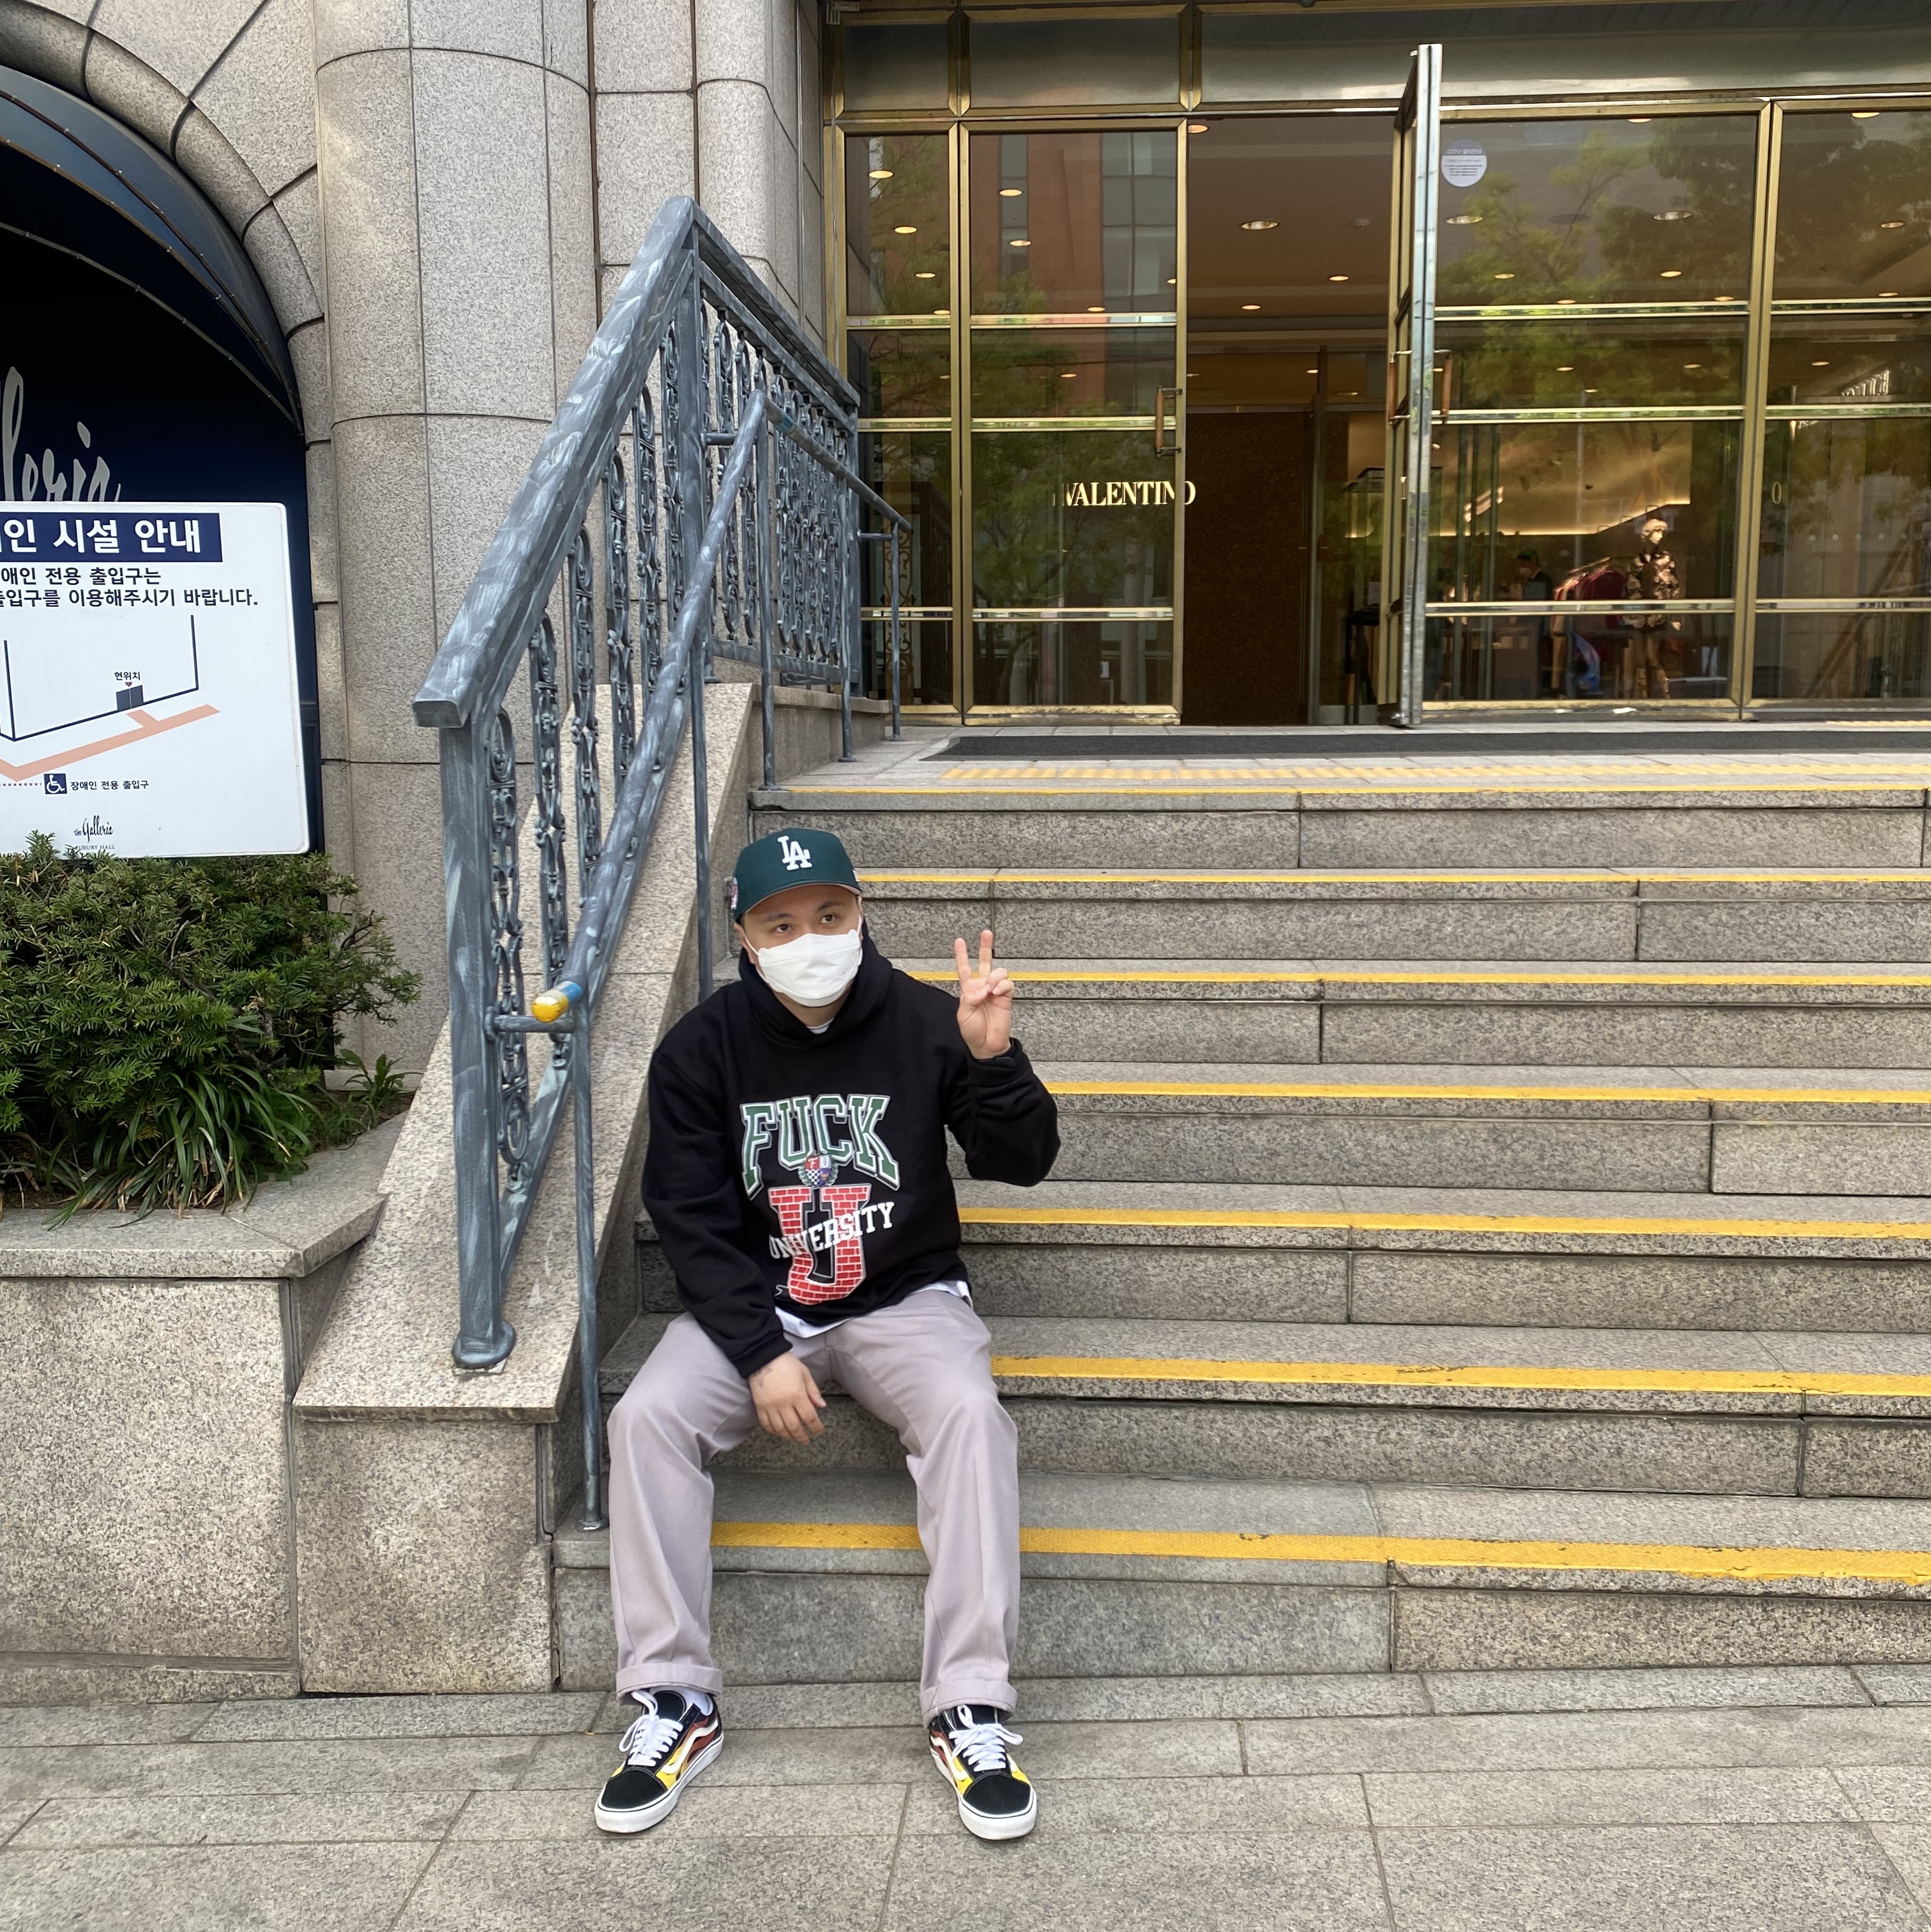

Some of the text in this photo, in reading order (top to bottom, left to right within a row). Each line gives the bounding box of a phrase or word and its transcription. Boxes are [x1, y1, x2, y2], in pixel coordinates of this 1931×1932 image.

[0, 519, 201, 554] 인 시설 안내
[45, 567, 81, 585] 전용
[89, 567, 162, 586] 출입구는
[69, 589, 175, 607] 이용해주시기
[184, 588, 258, 606] 바랍니다.
[114, 671, 140, 681] 현위치
[70, 780, 149, 791] 장애인 전용 출입구
[82, 815, 114, 843] Galleria
[777, 835, 812, 871] LA
[740, 1094, 900, 1200] FUCK
[769, 1202, 895, 1259] UNIVERSITY
